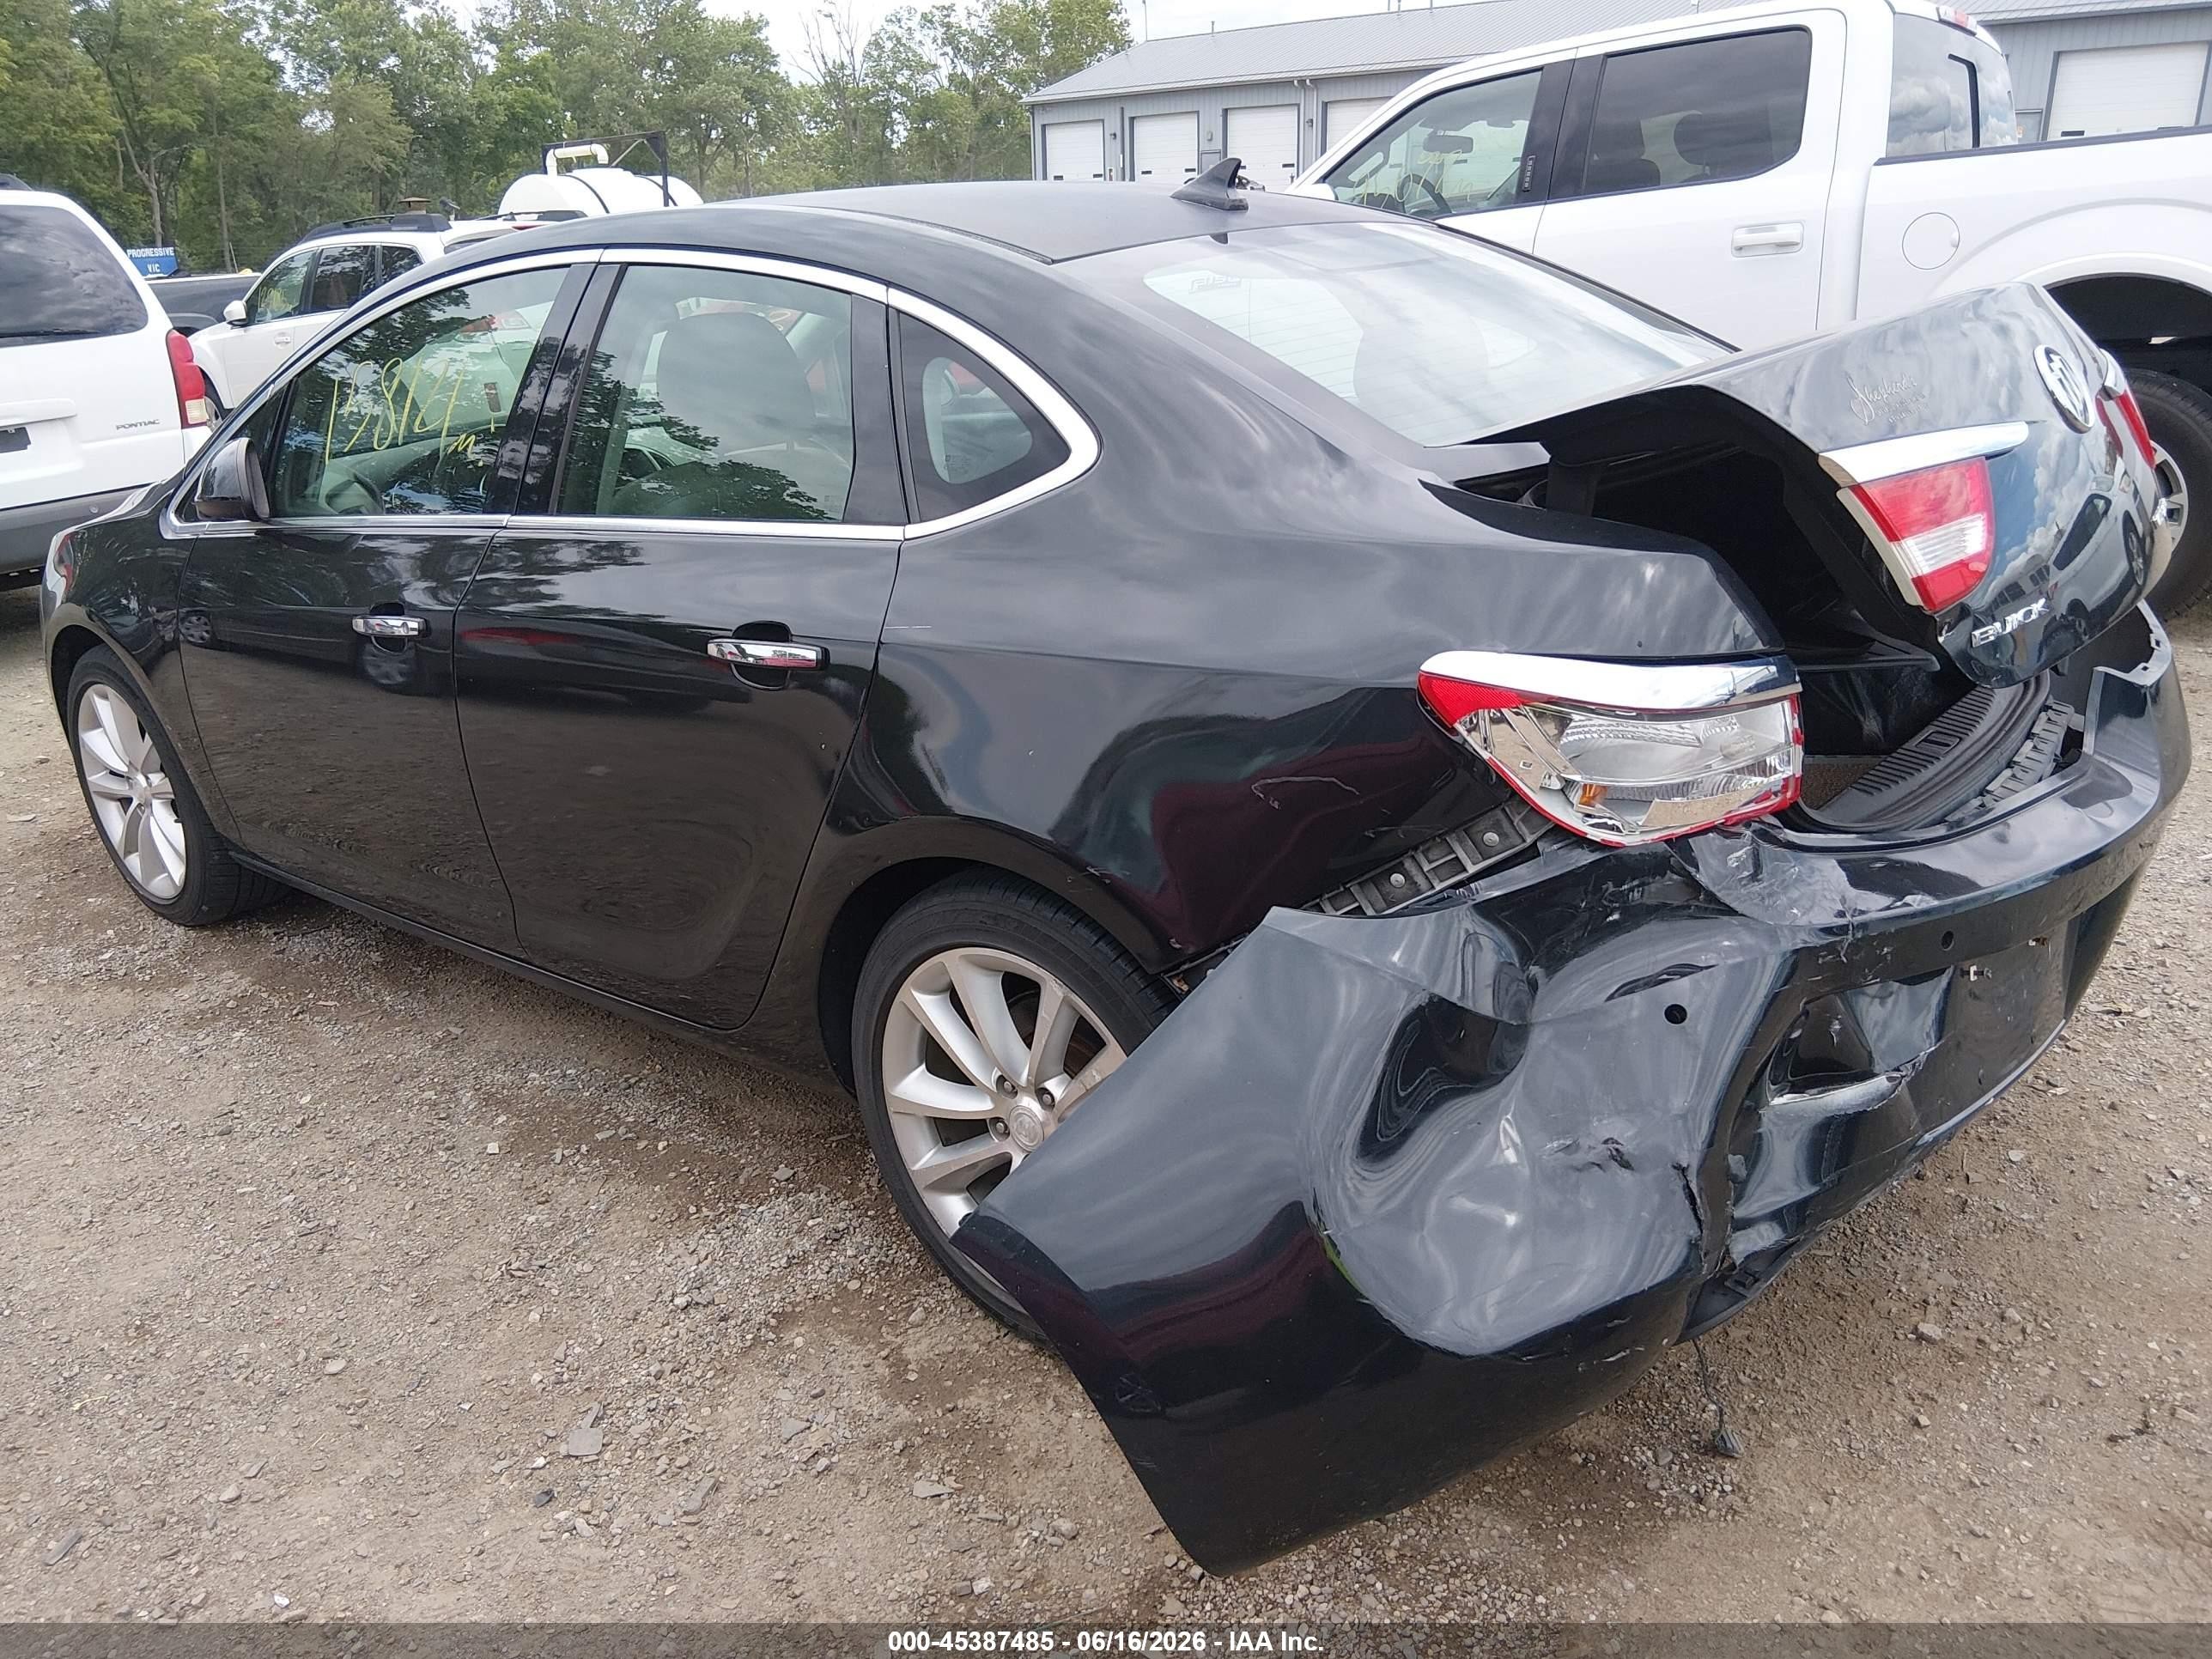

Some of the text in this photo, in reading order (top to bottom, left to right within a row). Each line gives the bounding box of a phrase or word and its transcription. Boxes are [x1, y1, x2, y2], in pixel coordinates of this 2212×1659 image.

[126, 246, 175, 258] PROGRESSIVE
[147, 263, 161, 273] VIC
[115, 418, 161, 430] PONTIAC
[1971, 598, 2050, 648] BUICK
